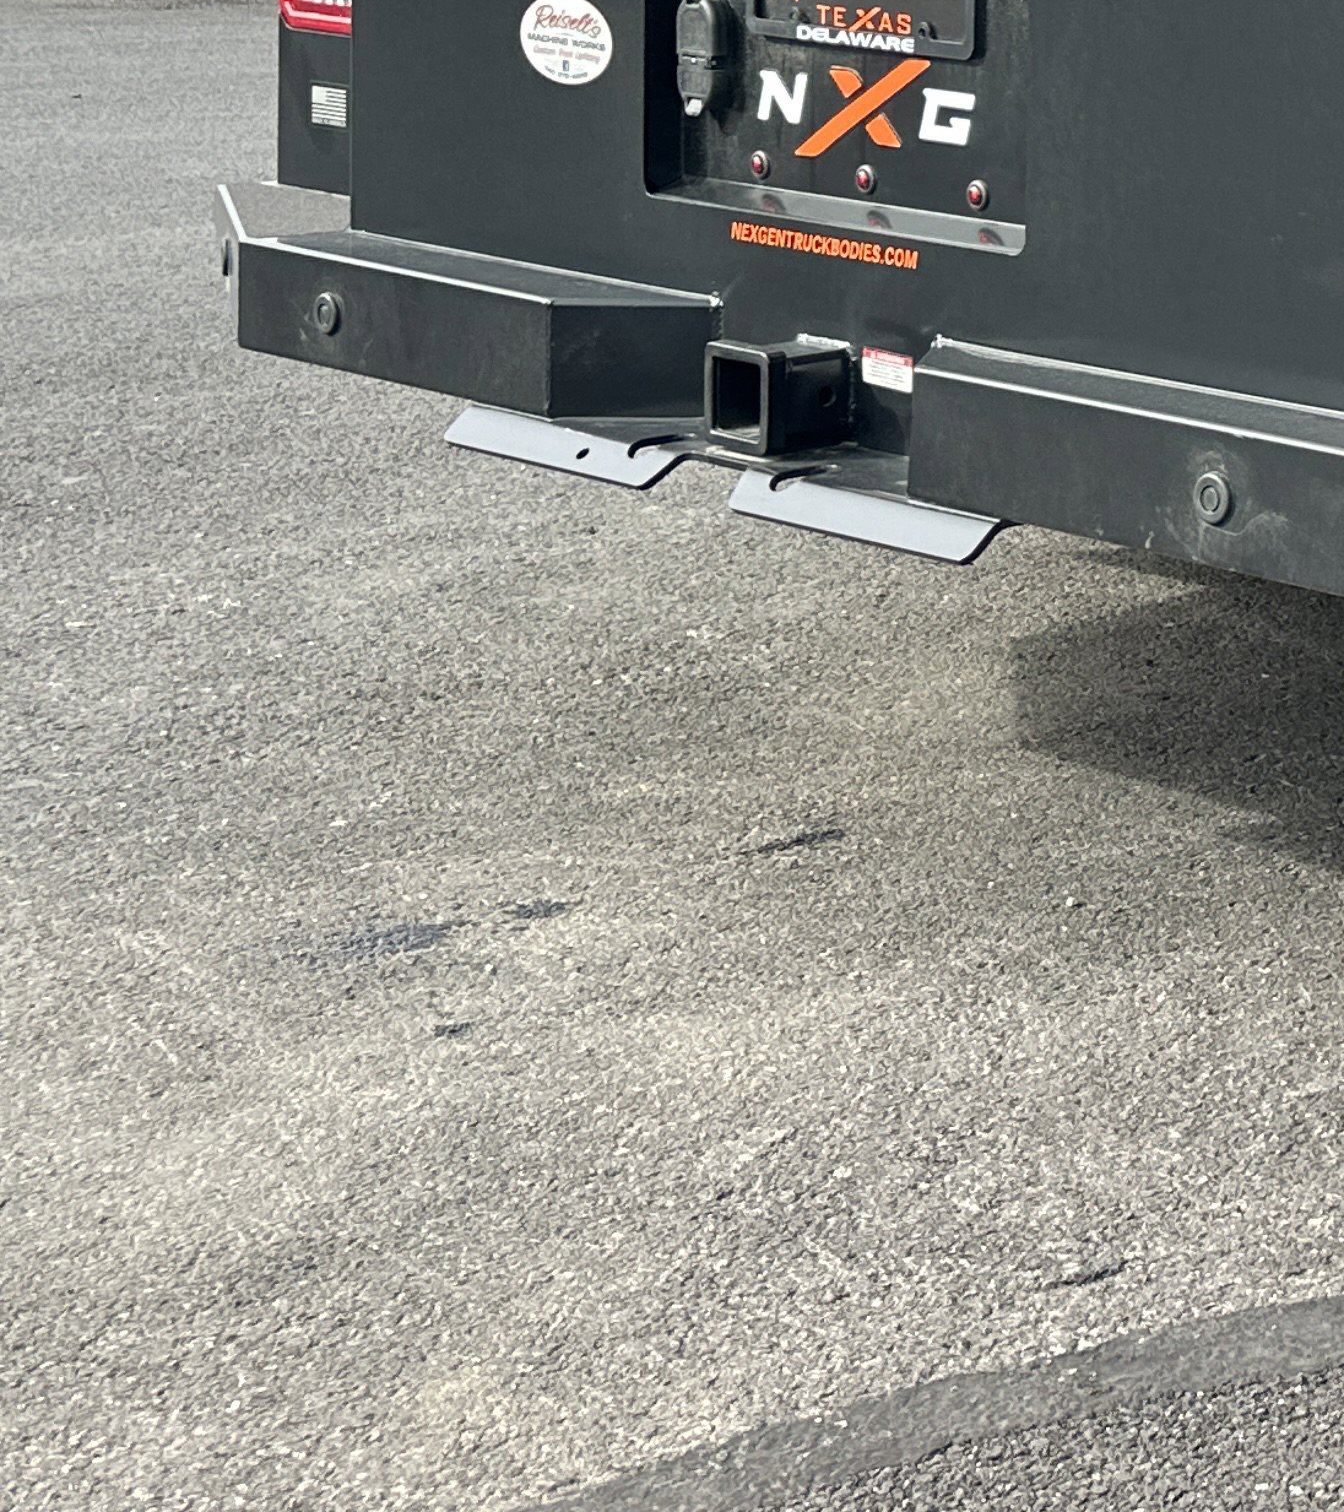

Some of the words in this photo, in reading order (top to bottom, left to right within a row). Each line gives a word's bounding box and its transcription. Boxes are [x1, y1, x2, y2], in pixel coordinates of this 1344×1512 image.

[816, 4, 912, 35] TEXAS
[796, 25, 915, 53] DELAWARE
[730, 221, 918, 270] NEXGENTRUCKBODIES.COM
